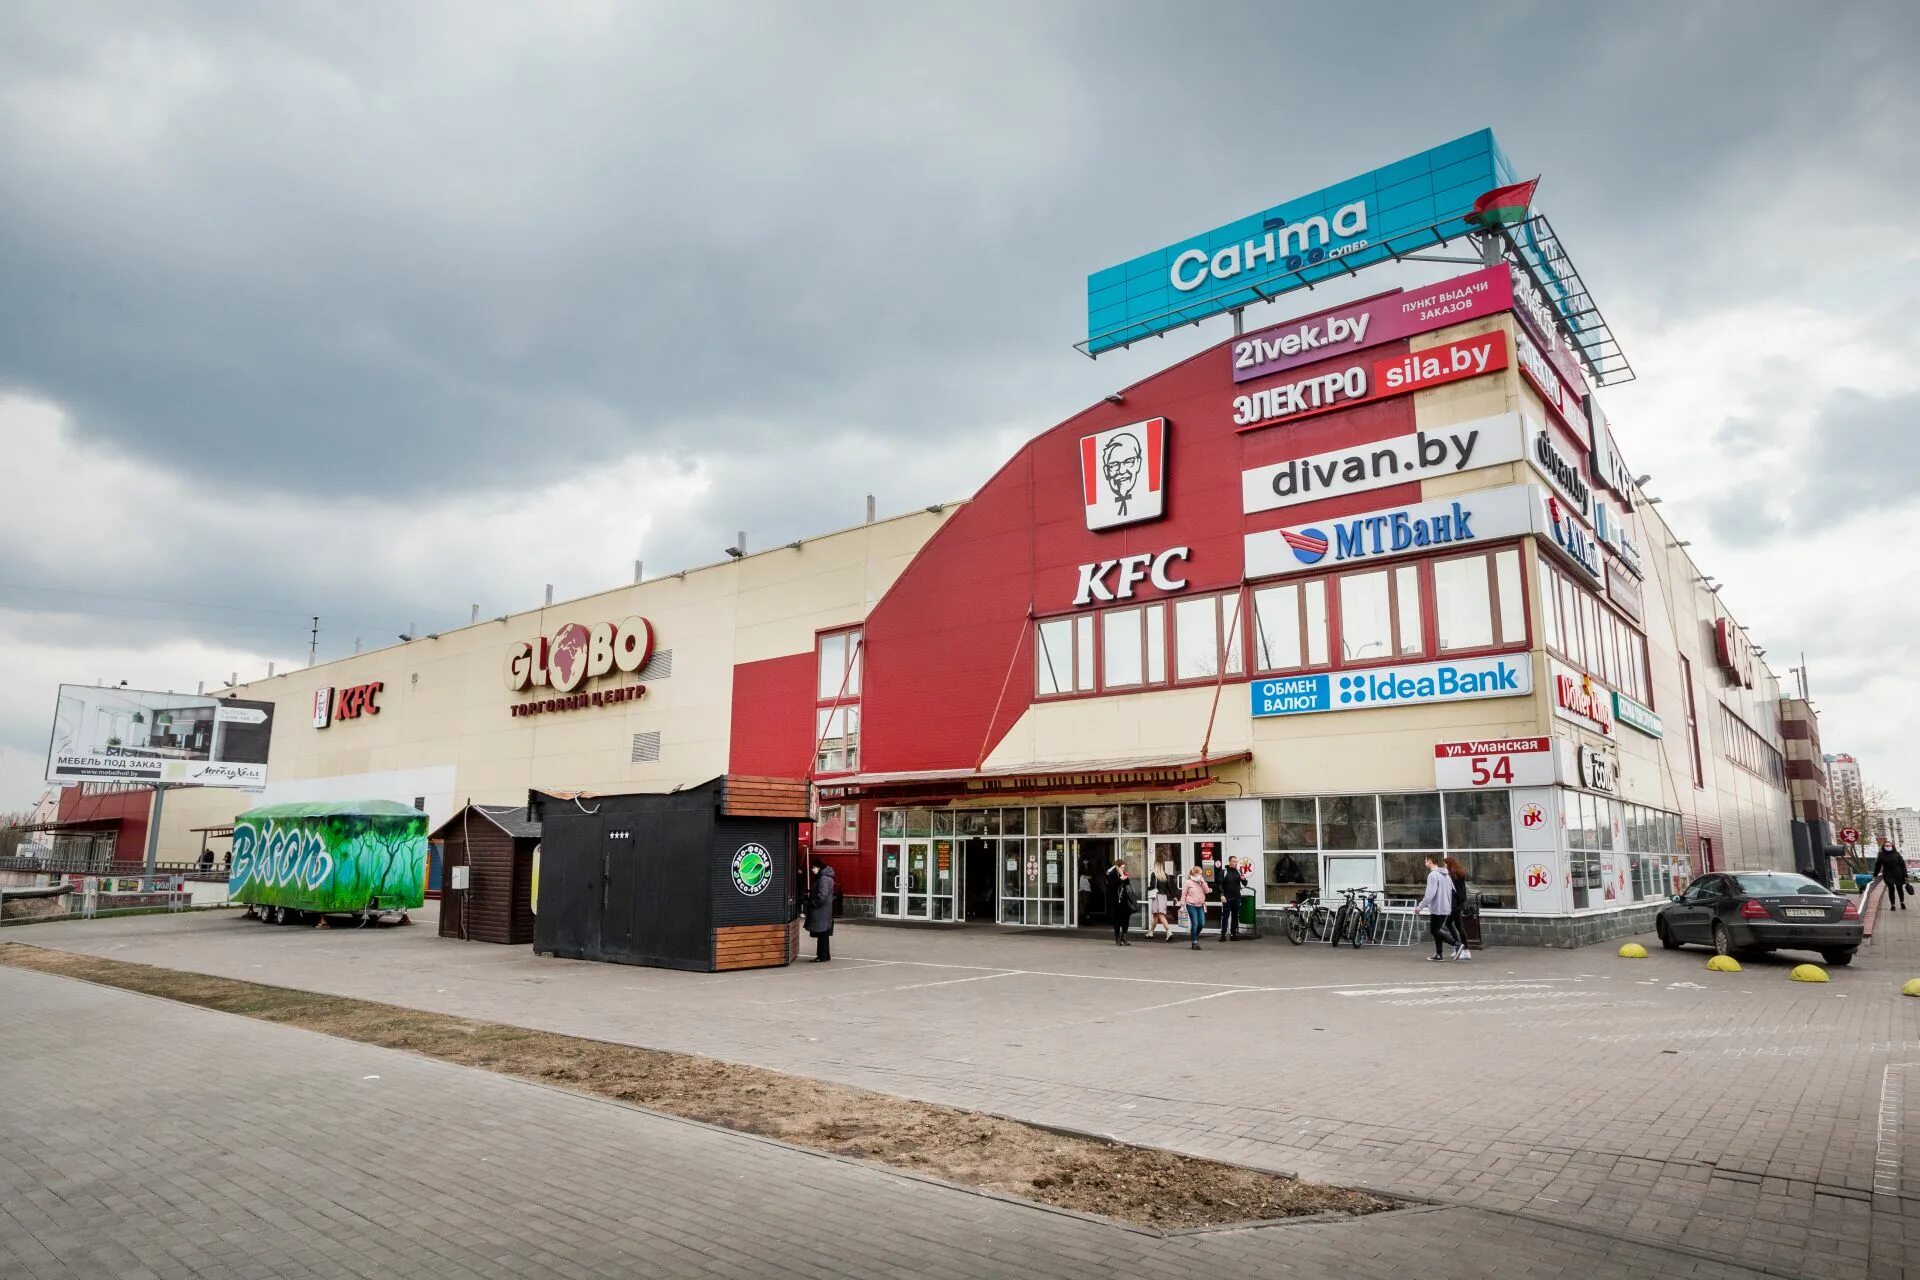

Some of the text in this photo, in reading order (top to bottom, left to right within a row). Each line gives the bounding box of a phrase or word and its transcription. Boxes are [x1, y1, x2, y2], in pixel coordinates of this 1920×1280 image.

[1170, 200, 1368, 292] Санта
[1328, 239, 1369, 259] СУПЕР
[1402, 281, 1489, 313] ПУНКТ ВЫДАЧИ
[1419, 299, 1473, 321] ЗАКАЗОВ
[1234, 312, 1370, 370] 21vek.by
[1233, 343, 1491, 426] ЭЛЕКТРО sila.by
[1272, 430, 1479, 497] divan.by
[1072, 546, 1190, 606] KFC
[503, 615, 655, 693] GLOBO
[1263, 680, 1317, 697] ОБМЕН
[1369, 661, 1519, 702] Idea Bank
[335, 682, 385, 720] KFC
[510, 685, 647, 718] ТОРГОВЫЙ ЦЕНТР
[1263, 694, 1318, 712] ВАЛЮТ
[57, 756, 162, 769] МЕБЕЛЬ ПОД ЗАКАЗ
[1446, 737, 1539, 758] ул. Уманская
[1471, 756, 1515, 786] 54
[1523, 810, 1543, 827] DK
[229, 816, 334, 900] Bison
[736, 878, 768, 894] eco-farm
[1528, 872, 1547, 888] DK
